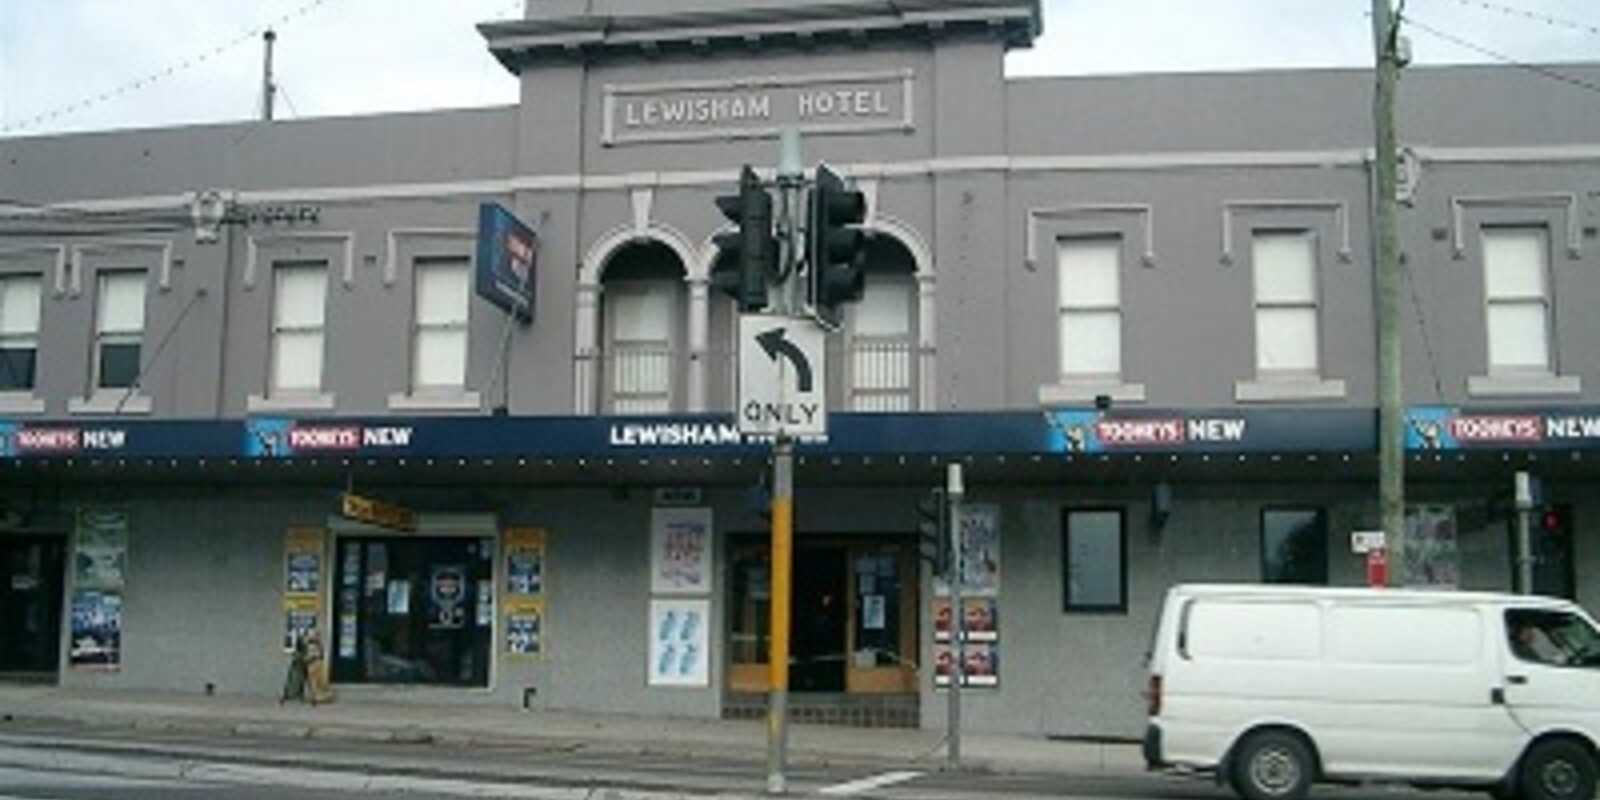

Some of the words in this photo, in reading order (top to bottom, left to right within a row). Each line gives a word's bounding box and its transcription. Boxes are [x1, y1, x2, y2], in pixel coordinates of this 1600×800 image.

[625, 94, 770, 125] LEWISHAM
[798, 90, 889, 116] HOTEL
[743, 401, 818, 425] ONLY
[83, 429, 126, 447] NEW
[363, 427, 413, 446] NEW
[610, 423, 741, 445] LEWISHAM
[1188, 418, 1246, 441] NEW
[1547, 416, 1600, 438] NEW
